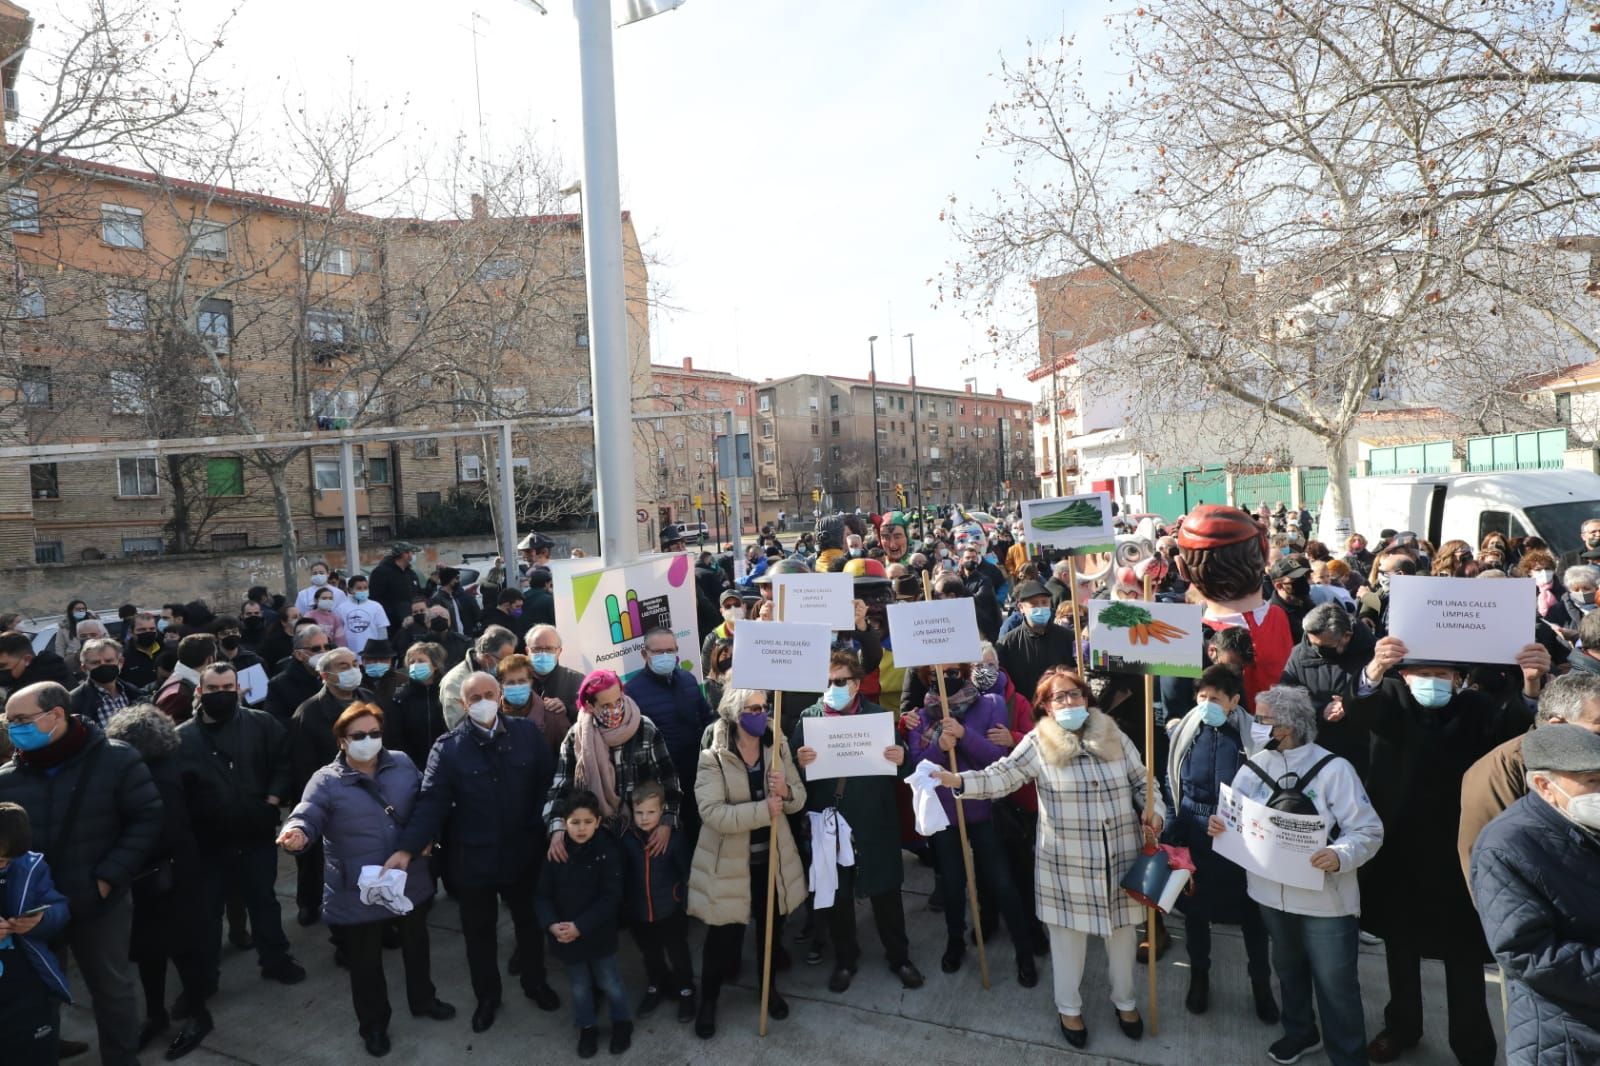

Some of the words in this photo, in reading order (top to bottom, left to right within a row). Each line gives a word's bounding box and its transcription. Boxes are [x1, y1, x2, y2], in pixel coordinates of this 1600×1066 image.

[1426, 599, 1443, 607] POR
[1445, 600, 1468, 608] UNAS
[1468, 600, 1497, 608] CALLES
[1442, 610, 1474, 618] LIMPIAS
[1475, 611, 1481, 619] E
[1435, 622, 1487, 630] ILUMINADAS
[595, 647, 632, 663] Asociación
[761, 648, 792, 656] COMERCIO
